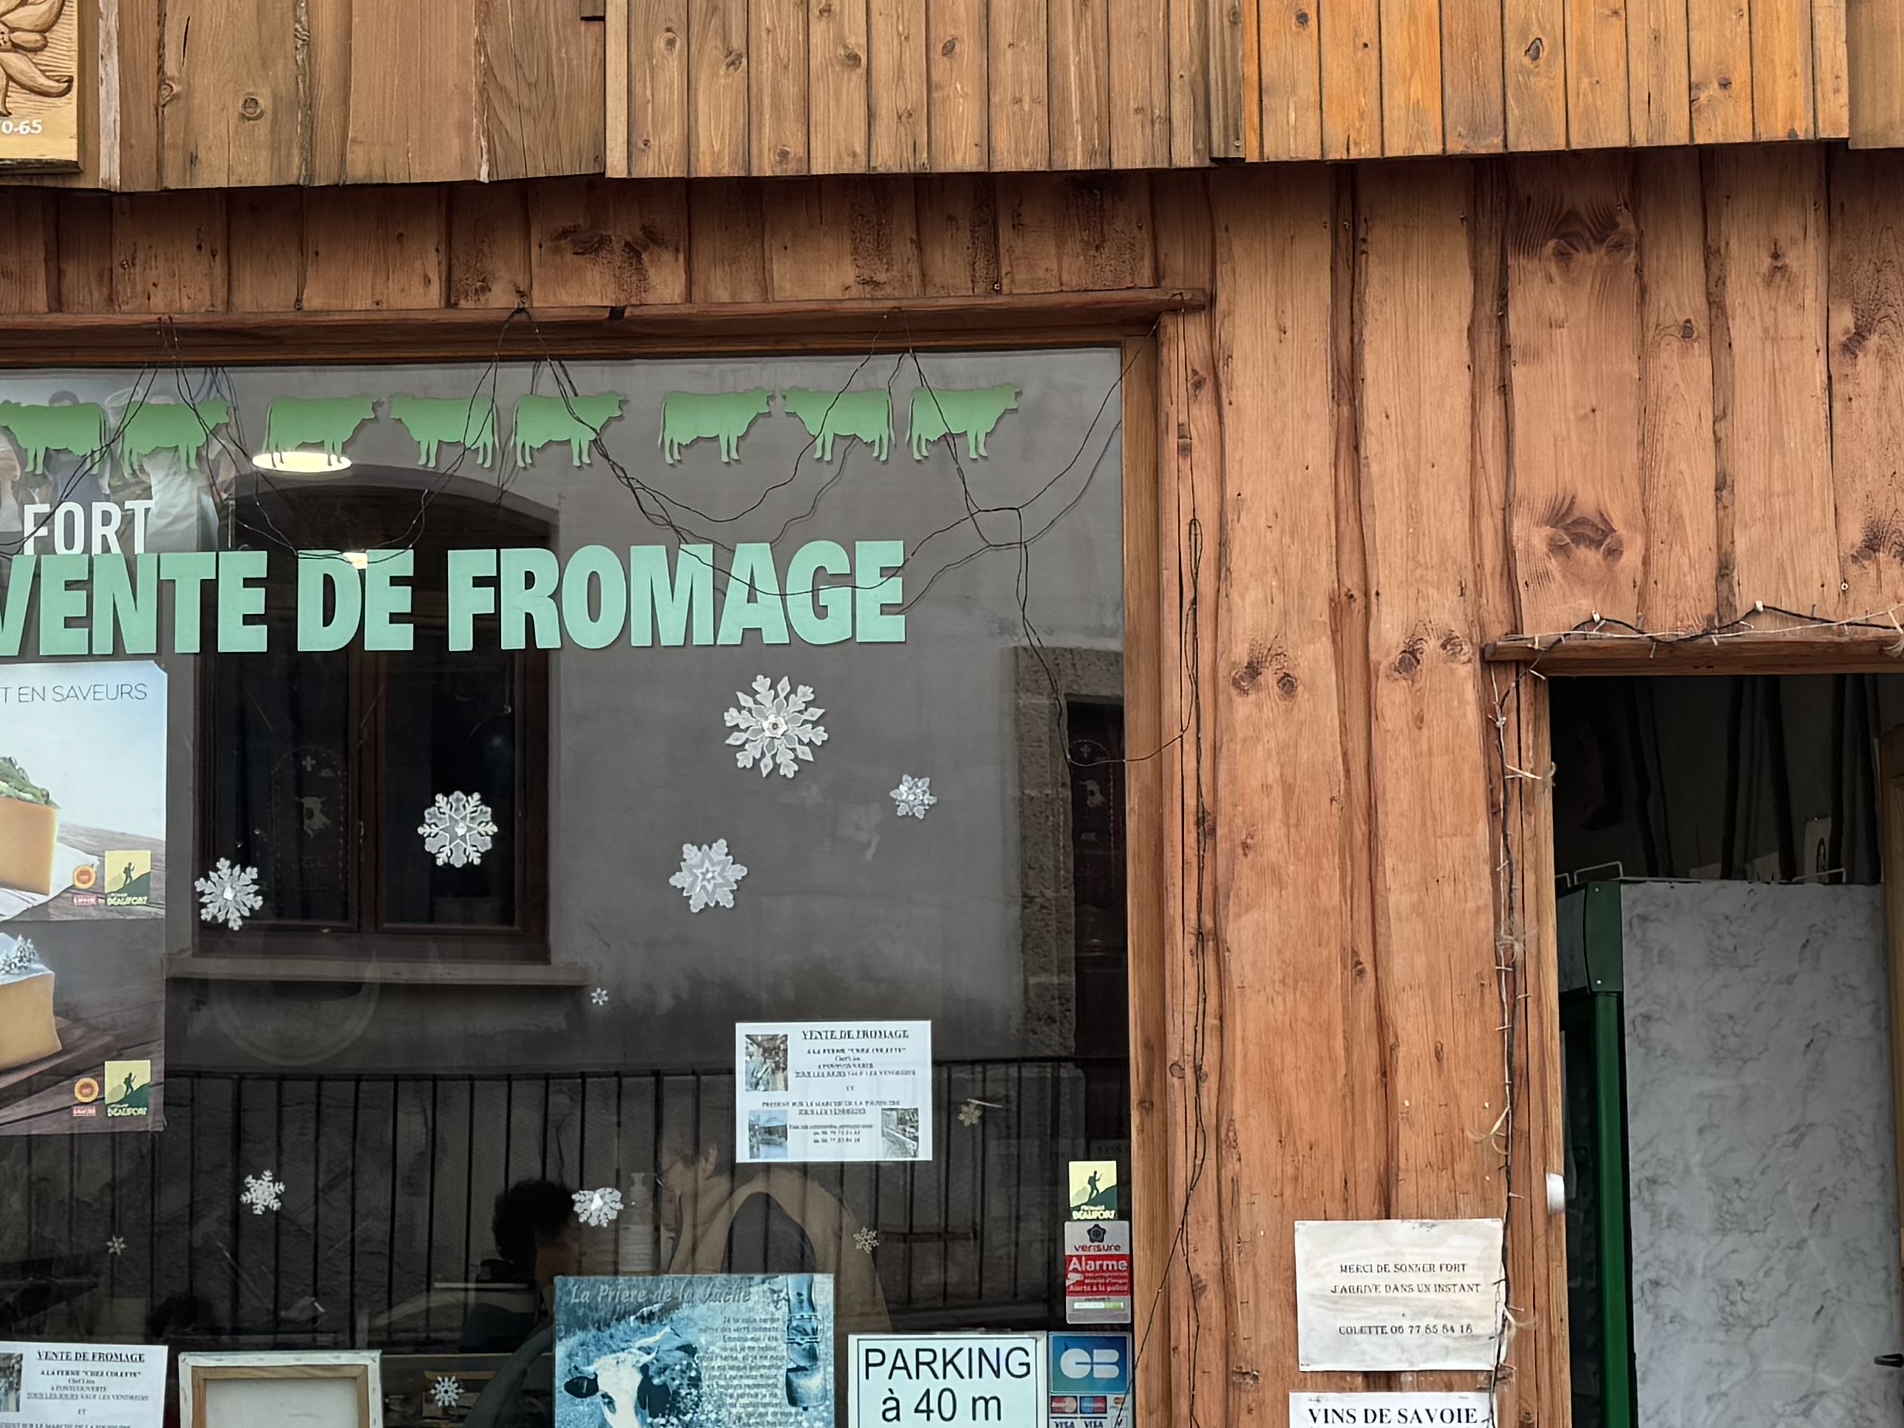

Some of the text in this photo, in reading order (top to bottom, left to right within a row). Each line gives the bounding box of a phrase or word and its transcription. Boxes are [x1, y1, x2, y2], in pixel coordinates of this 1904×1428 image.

[23, 499, 153, 555] FORT
[297, 550, 414, 654] DE
[447, 539, 907, 650] FROMAGE
[19, 684, 46, 703] EN
[51, 682, 148, 702] SAVEURS
[1074, 1243, 1121, 1252] verisure
[1068, 1255, 1128, 1271] Alarme
[1340, 1263, 1468, 1273] MERCI DE SONNER FORT
[570, 1283, 591, 1304] La
[653, 1281, 673, 1303] de
[1384, 1283, 1414, 1293] DANS
[1417, 1283, 1431, 1293] UN
[1433, 1283, 1481, 1293] INSTANT
[1338, 1325, 1388, 1335] COLETTE
[1390, 1325, 1405, 1335] 06
[1408, 1325, 1421, 1335] 77
[36, 1350, 145, 1363] VENTE DE FROMAGE
[864, 1346, 1031, 1380] PARKING
[881, 1387, 1002, 1422] à 40 m
[1084, 1420, 1104, 1428] VISA
[1308, 1408, 1478, 1424] VINS DE SAVOIE
[1054, 1421, 1075, 1428] VISA
